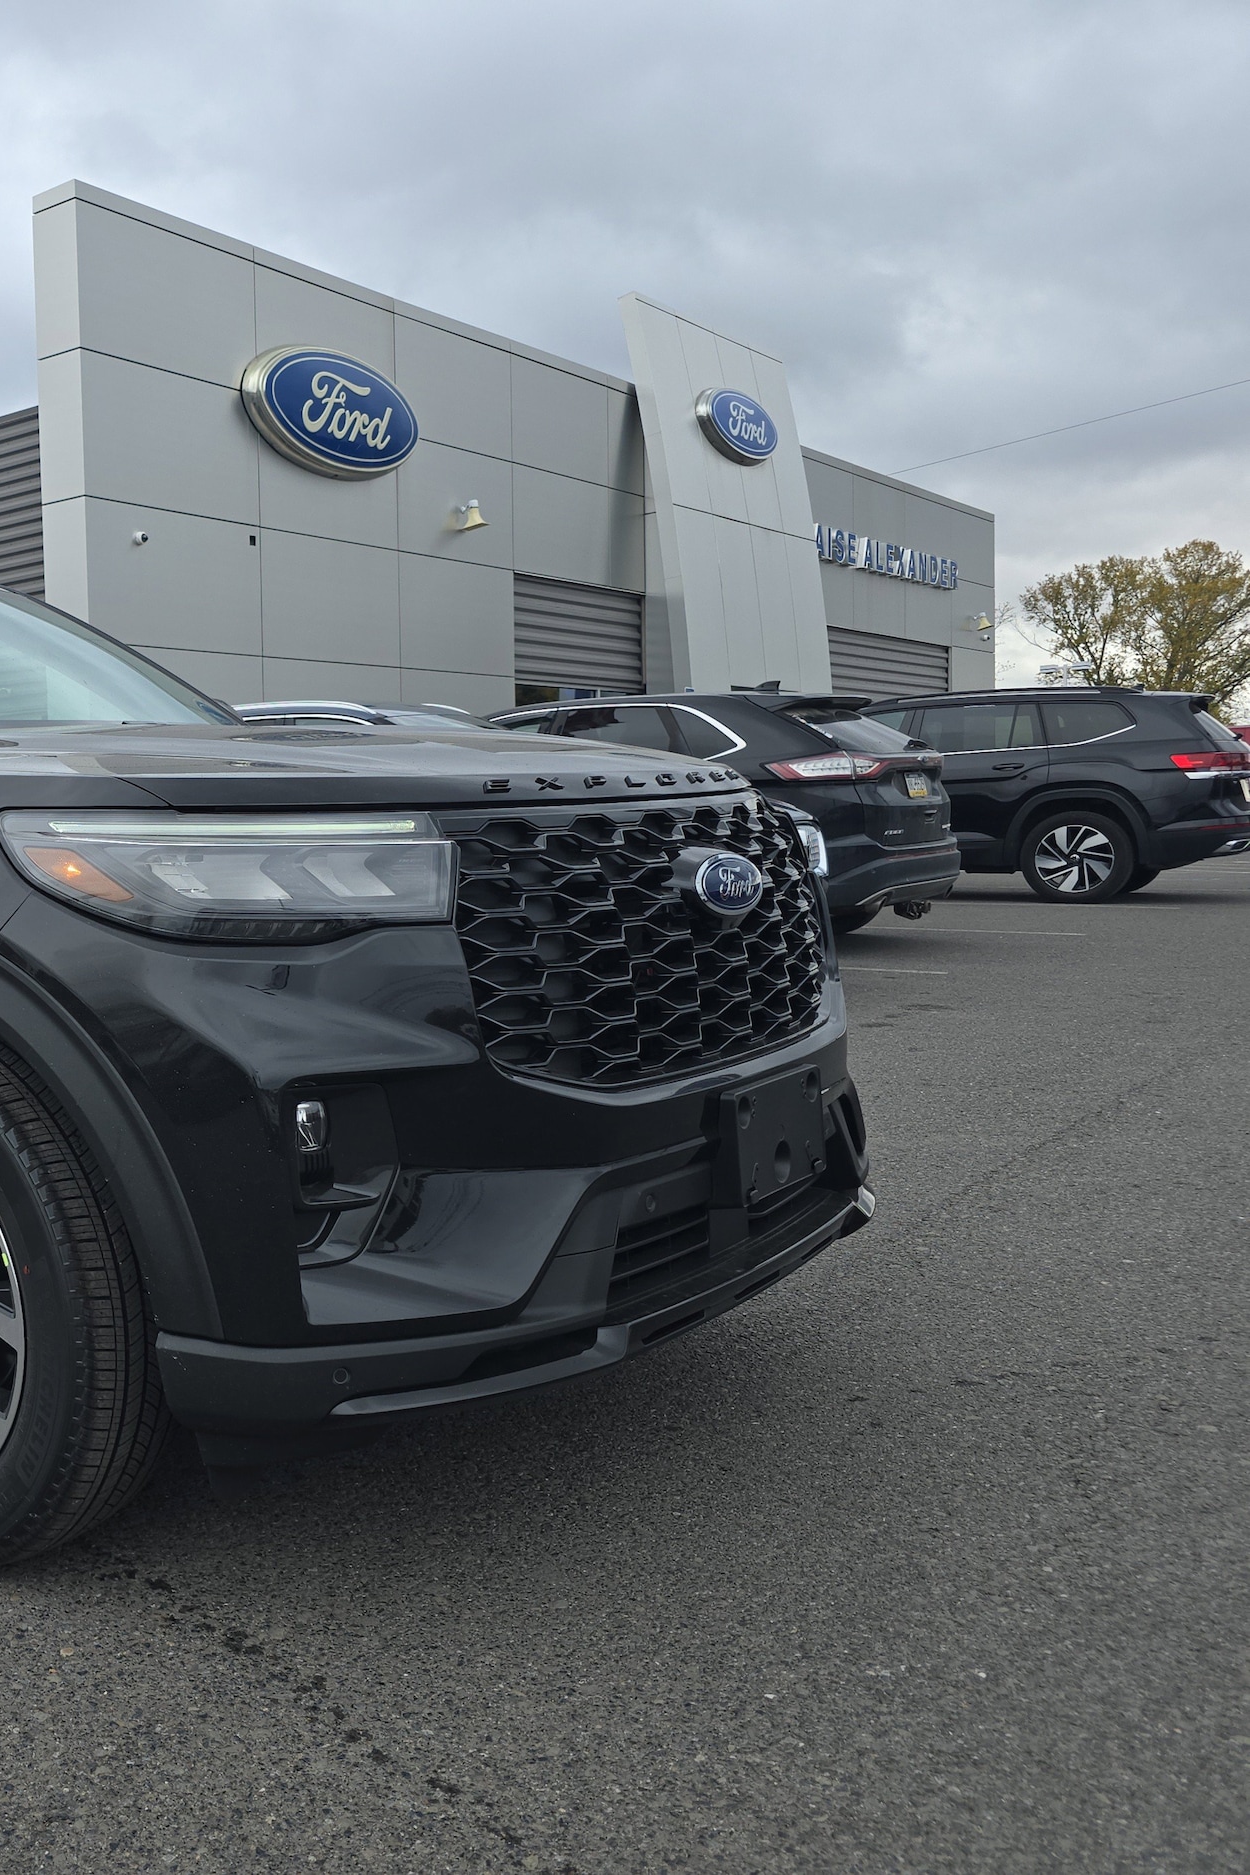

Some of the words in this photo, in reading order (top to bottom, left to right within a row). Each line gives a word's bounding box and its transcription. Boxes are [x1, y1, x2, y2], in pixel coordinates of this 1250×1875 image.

[301, 370, 393, 451] Ford
[728, 401, 768, 446] Ford
[858, 536, 959, 590] ALEXANDER
[718, 866, 755, 901] Ford
